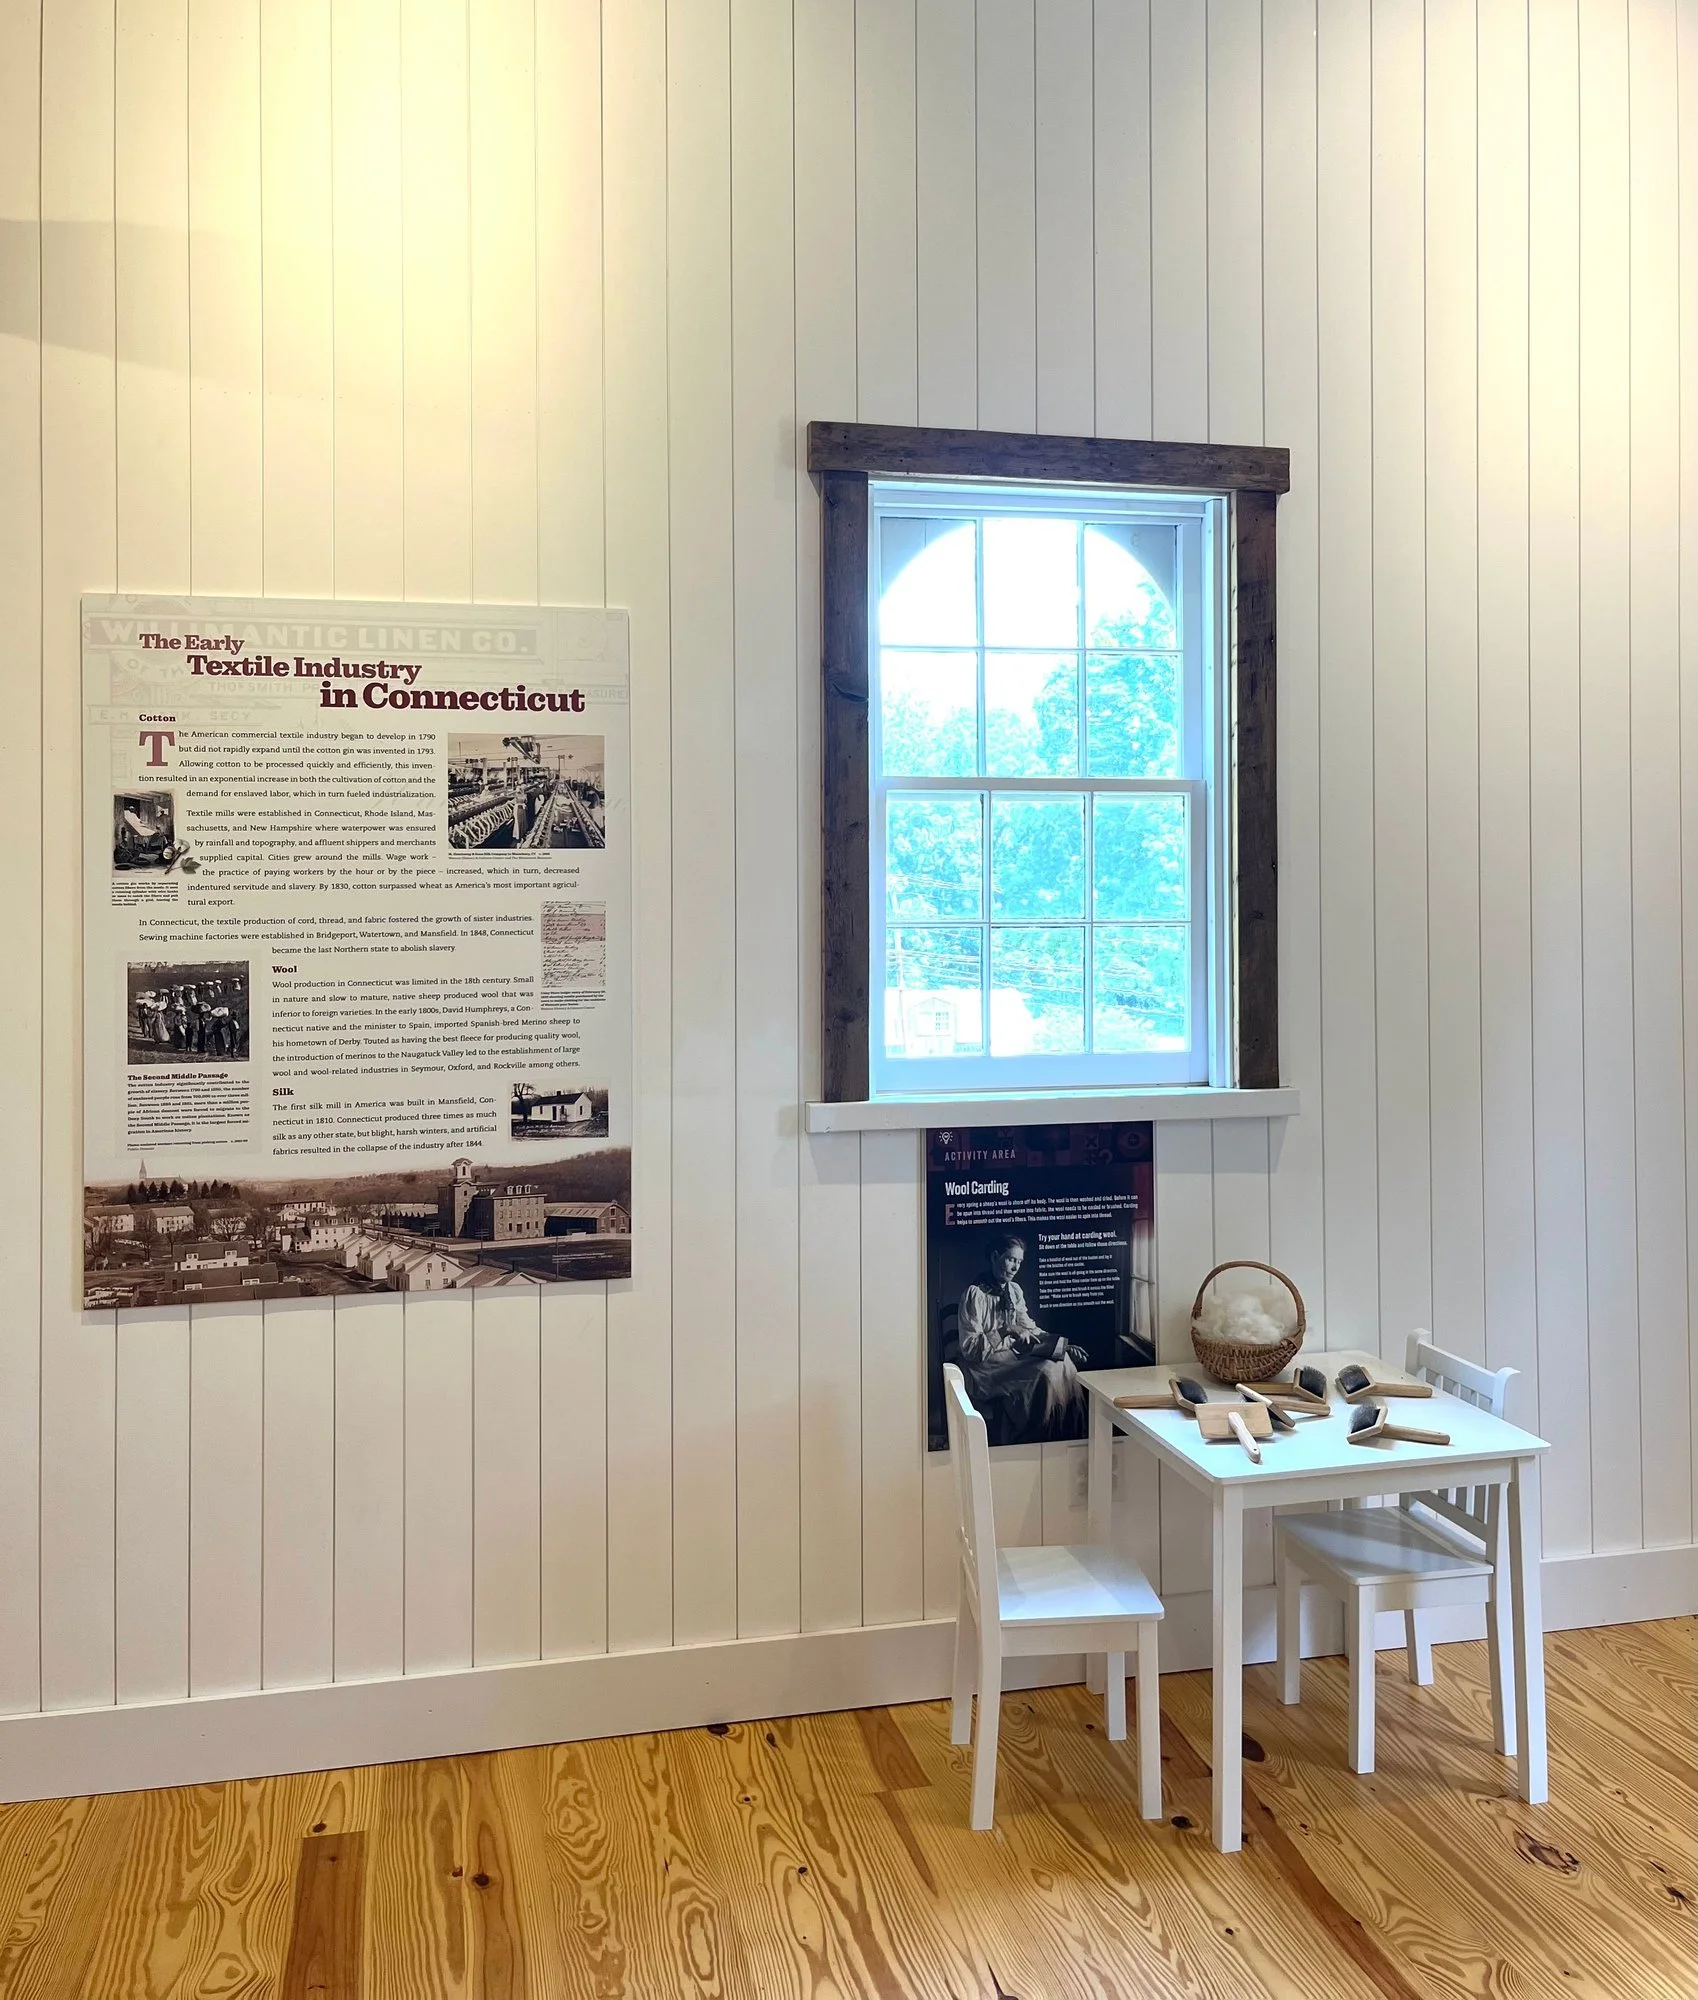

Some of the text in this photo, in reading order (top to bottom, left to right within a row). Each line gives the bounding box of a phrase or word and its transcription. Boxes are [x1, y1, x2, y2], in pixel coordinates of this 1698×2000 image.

[139, 633, 246, 656] The Early
[358, 627, 462, 651] LINEN
[473, 630, 529, 652] CO.
[187, 655, 422, 685] Textile Industry
[320, 681, 585, 713] in Connecticut
[139, 714, 176, 722] Cotton
[232, 731, 277, 740] commercial
[306, 732, 339, 741] industry
[341, 732, 364, 741] began
[377, 733, 406, 741] develop
[179, 760, 214, 769] Allowing
[266, 761, 304, 769] processed
[306, 761, 334, 770] quickly
[353, 761, 393, 770] efficiently,
[270, 790, 291, 798] labor,
[314, 810, 362, 818] Connecticut,
[391, 810, 416, 818] Island,
[187, 824, 230, 832] sachusetts,
[270, 824, 312, 833] Hampshire
[194, 839, 204, 848] by
[252, 839, 297, 848] topography,
[346, 839, 379, 848] shippers
[272, 965, 297, 973] Wool
[294, 980, 335, 989] production
[347, 979, 393, 987] Connecticut
[401, 1036, 427, 1044] having
[496, 1033, 533, 1042] producing
[534, 1032, 560, 1041] quality
[272, 1088, 295, 1096] Silk
[355, 1100, 386, 1108] America
[438, 1097, 477, 1105] Mansfield,
[300, 1146, 331, 1154] resulted
[357, 1144, 388, 1153] collapse
[413, 1142, 445, 1150] industry
[945, 1149, 1016, 1161] ACTIVITY AREA
[945, 1180, 1009, 1196] Wool Carding
[1039, 1233, 1047, 1242] Try
[1048, 1234, 1060, 1242] your
[1060, 1232, 1075, 1240] hand
[1081, 1231, 1102, 1239] carding
